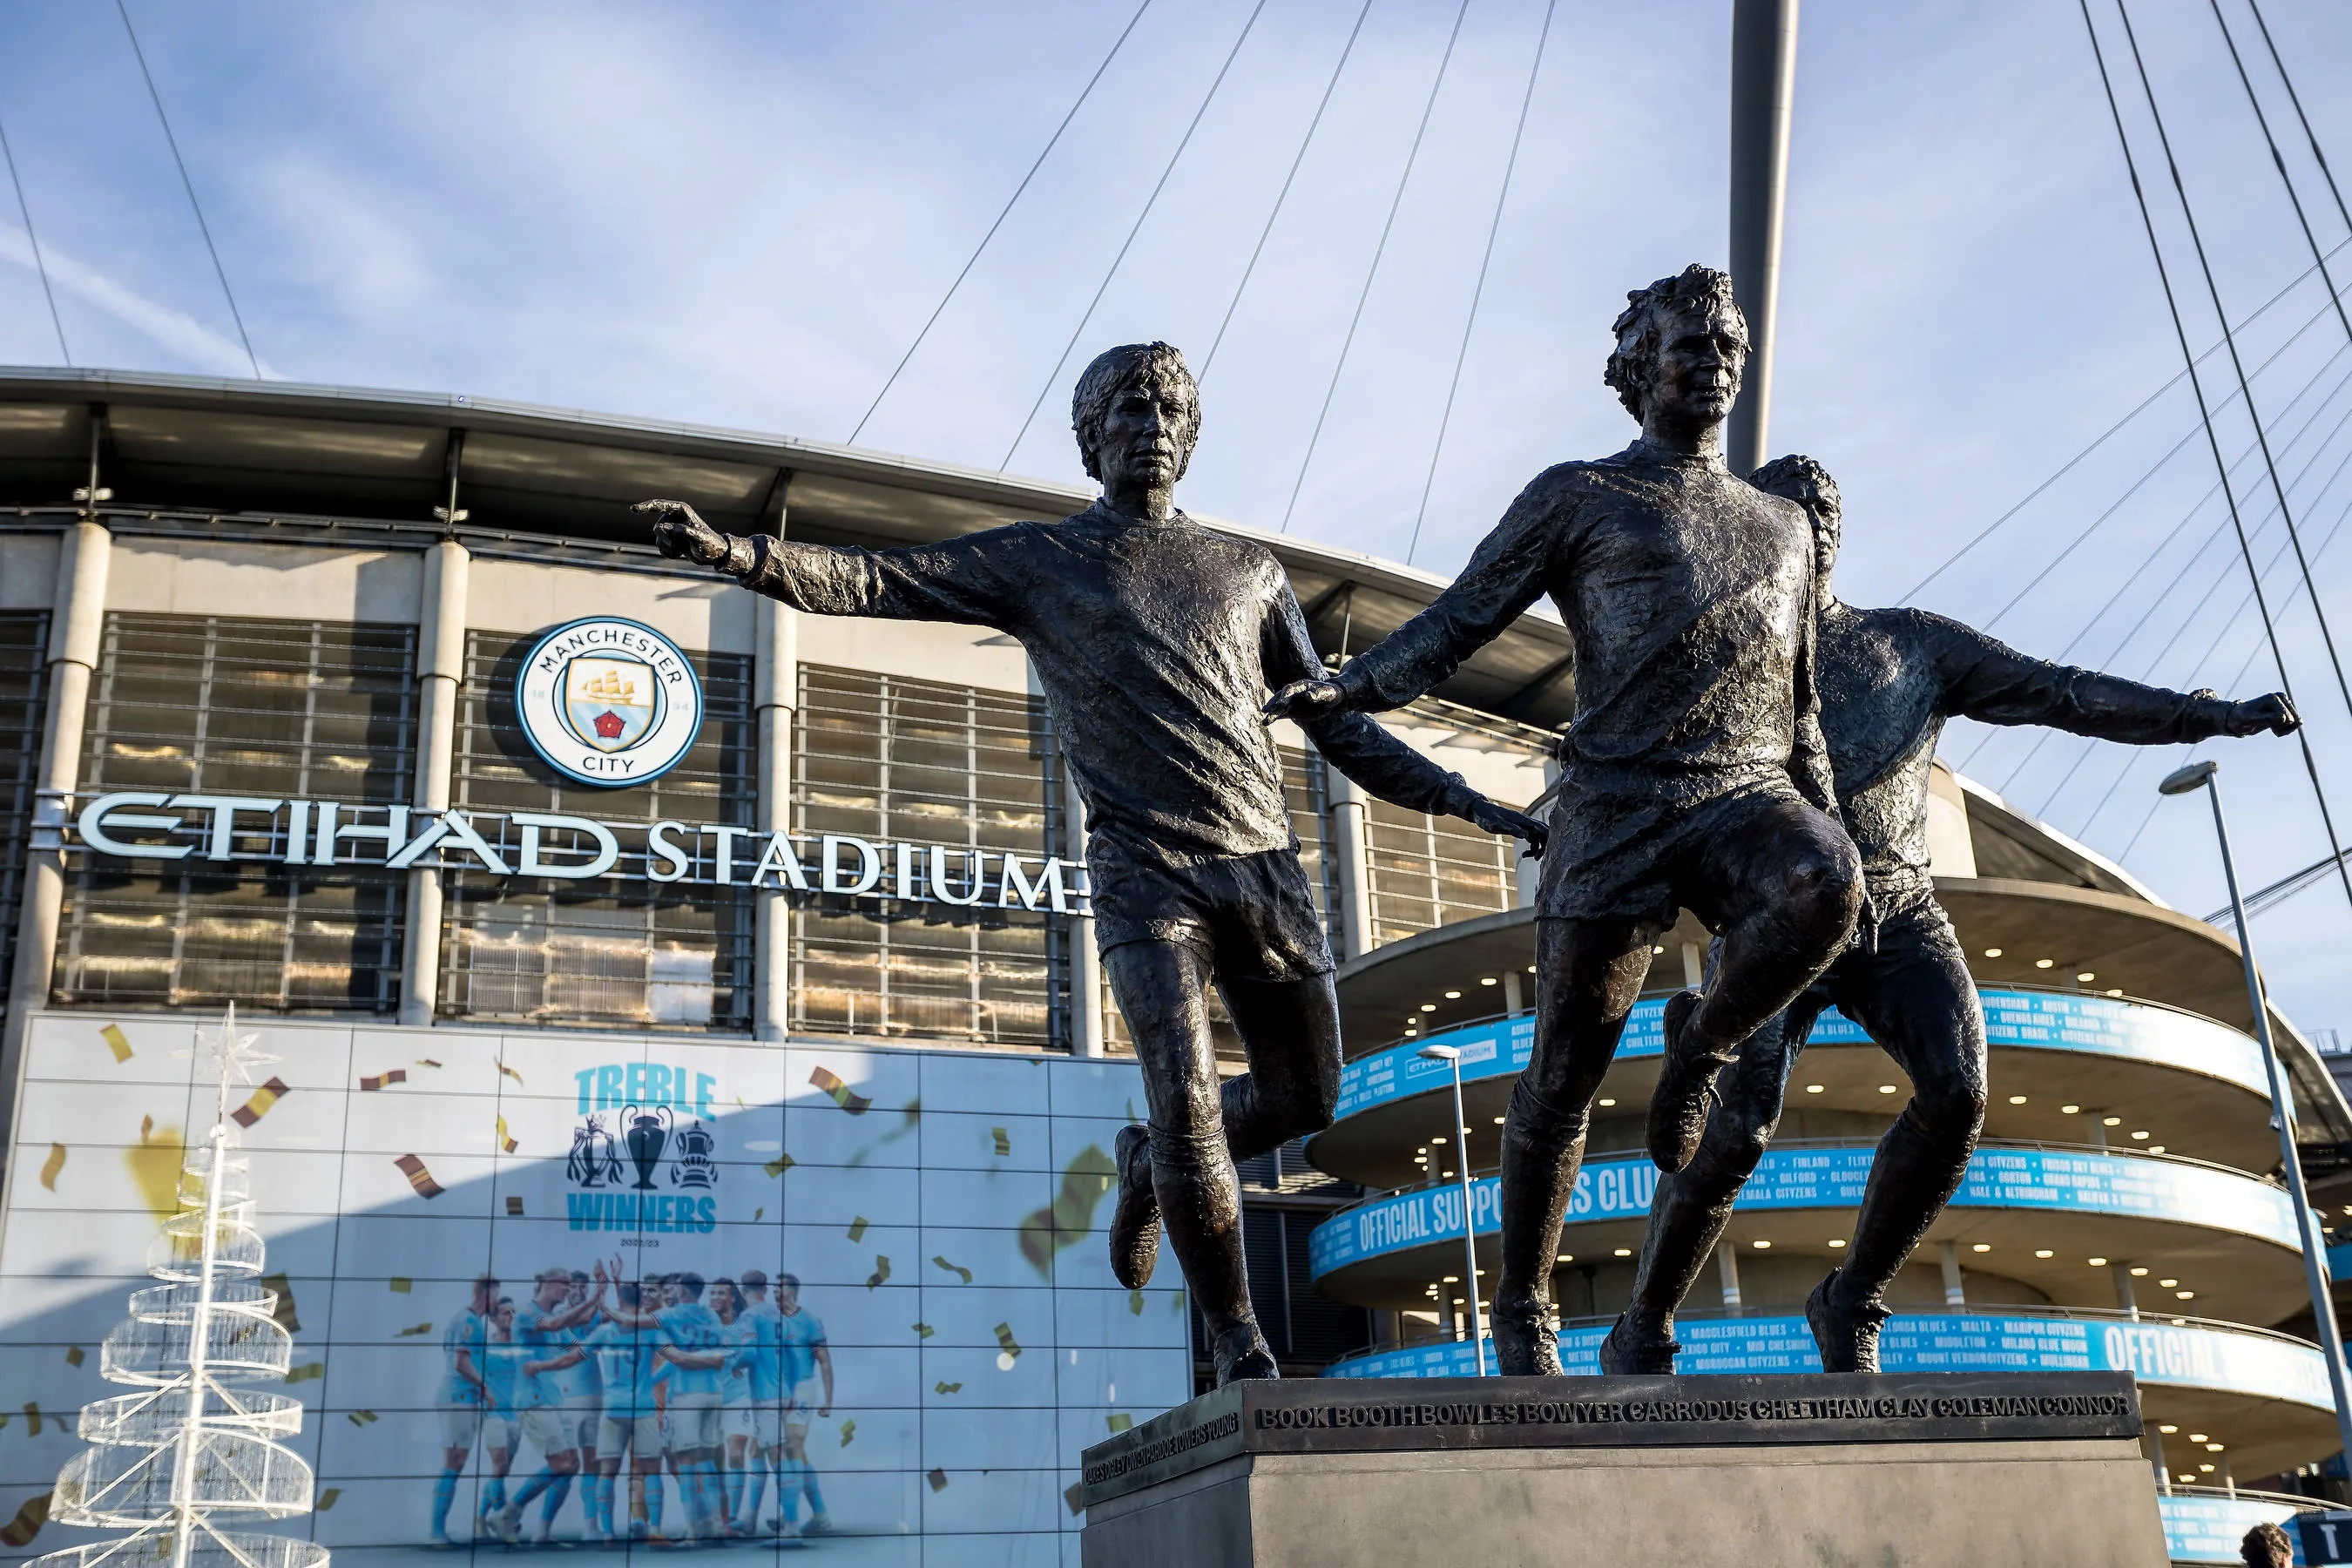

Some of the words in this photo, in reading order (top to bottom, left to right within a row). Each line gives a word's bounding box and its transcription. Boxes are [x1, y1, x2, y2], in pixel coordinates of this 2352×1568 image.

[540, 629, 682, 685] MANCHESTER
[583, 756, 635, 774] CITY
[78, 791, 618, 879] ETIHAD
[647, 820, 1068, 914] STADIUM
[574, 1062, 716, 1123] TREBLE
[1793, 1156, 1830, 1168] FINLAND
[1775, 1186, 1817, 1200] CITYZENS
[567, 1193, 716, 1234] WINNERS
[1359, 1191, 1430, 1253] OFFICIAL
[1691, 1324, 1756, 1339] MACCLESFIELD
[1758, 1323, 1787, 1335] BLUES
[1710, 1342, 1730, 1355] CITY
[1746, 1340, 1766, 1352] MID
[1767, 1339, 1811, 1352] CHESHIRE
[1747, 1355, 1790, 1369] CITYZENS
[2105, 1325, 2222, 1381] OFFICIAL
[1261, 1407, 1331, 1429] BOOK
[1335, 1404, 1416, 1427] BOOTH
[1421, 1403, 1519, 1425] BOWLES
[1524, 1402, 1624, 1423] BOWYER
[1629, 1400, 1751, 1422] CARRODUS
[1755, 1397, 1876, 1420] CHEETHAM
[1879, 1397, 1931, 1418] CLAY
[1937, 1396, 2042, 1417] COLEMAN
[2044, 1395, 2132, 1416] CONNOR
[1175, 1423, 1209, 1454] TOWERS
[1208, 1411, 1240, 1441] YOUNG
